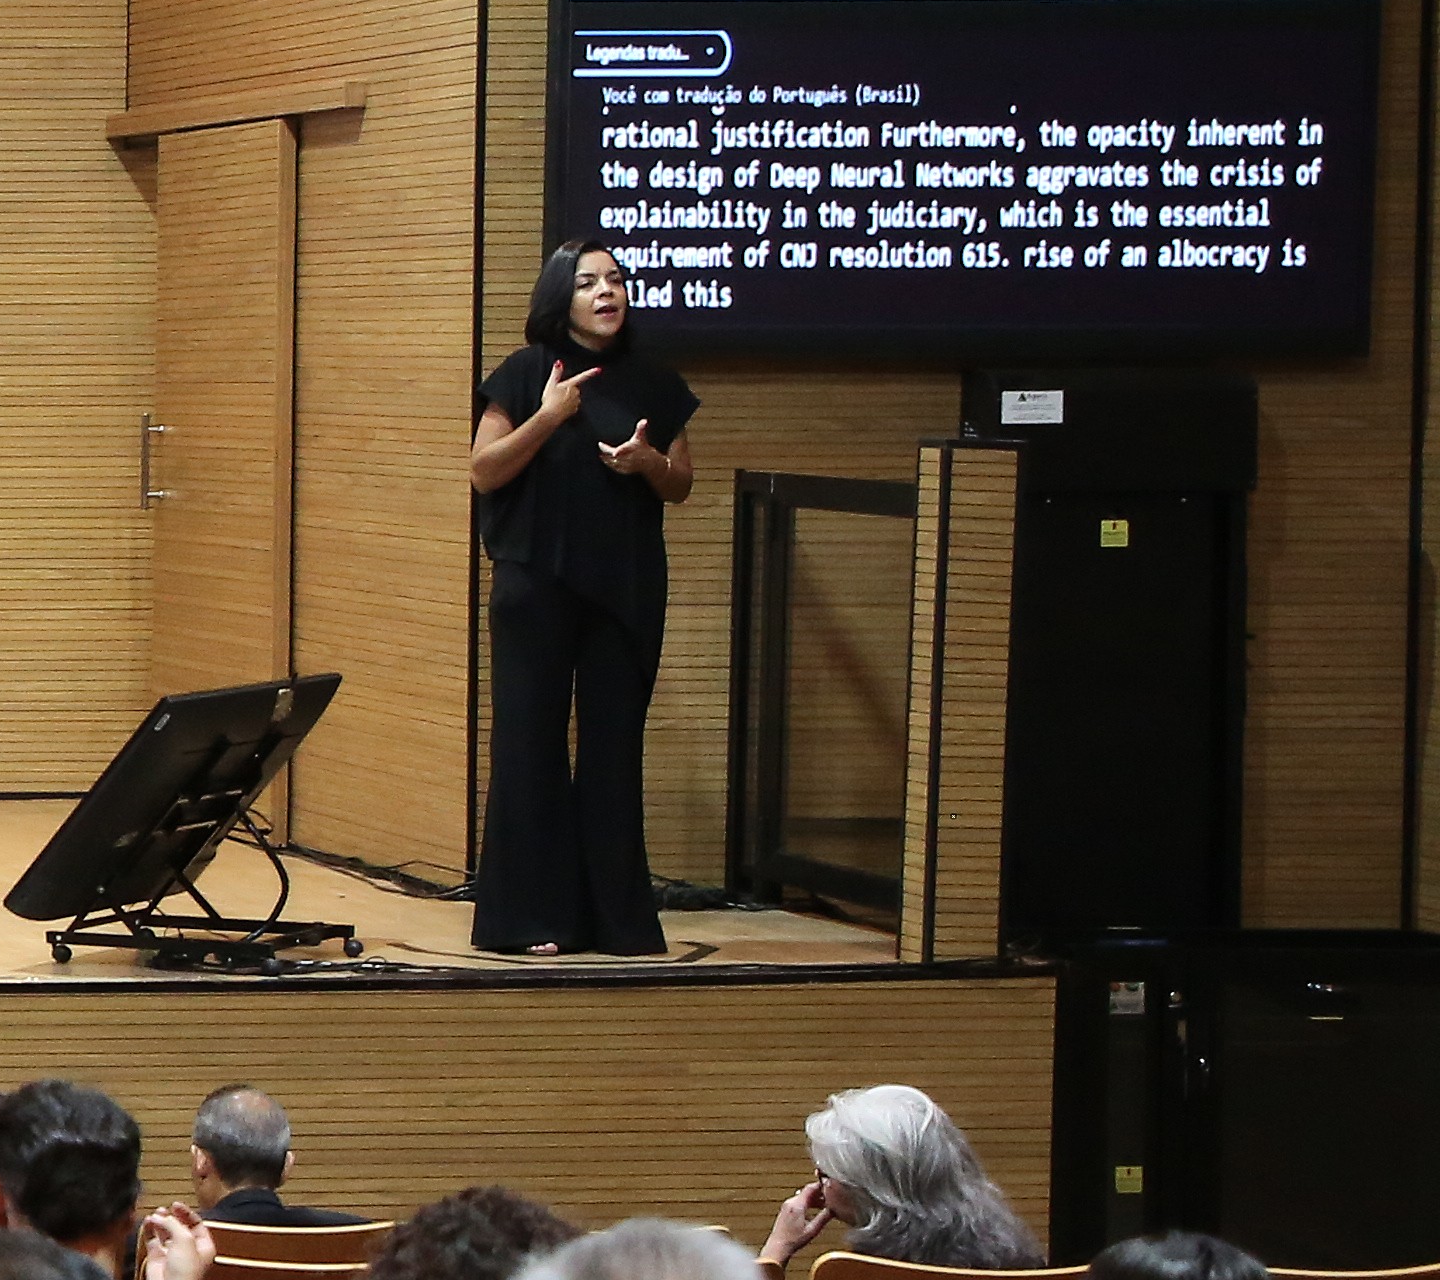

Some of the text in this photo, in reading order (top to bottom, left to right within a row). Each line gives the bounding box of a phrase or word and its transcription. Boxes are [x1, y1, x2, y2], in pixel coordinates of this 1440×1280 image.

[586, 43, 645, 65] Legendas
[603, 83, 919, 107] Você com tradução do Português (Brasil)
[603, 117, 1323, 155] rational justification Furthermore, the opacity inherent in
[601, 157, 1322, 196] the design of Deep Neural Networks aggravates the crisis of
[600, 198, 1270, 236] explainability in the judiciary, which is the essential
[744, 240, 770, 268] of
[781, 242, 817, 268] CNJ
[830, 239, 951, 269] resolution
[963, 241, 1009, 268] 615.
[1024, 239, 1074, 268] rise
[1084, 239, 1110, 267] of
[1121, 246, 1147, 268] an
[1158, 238, 1270, 273] albocracy
[1282, 238, 1306, 266] is
[683, 280, 732, 308] this
